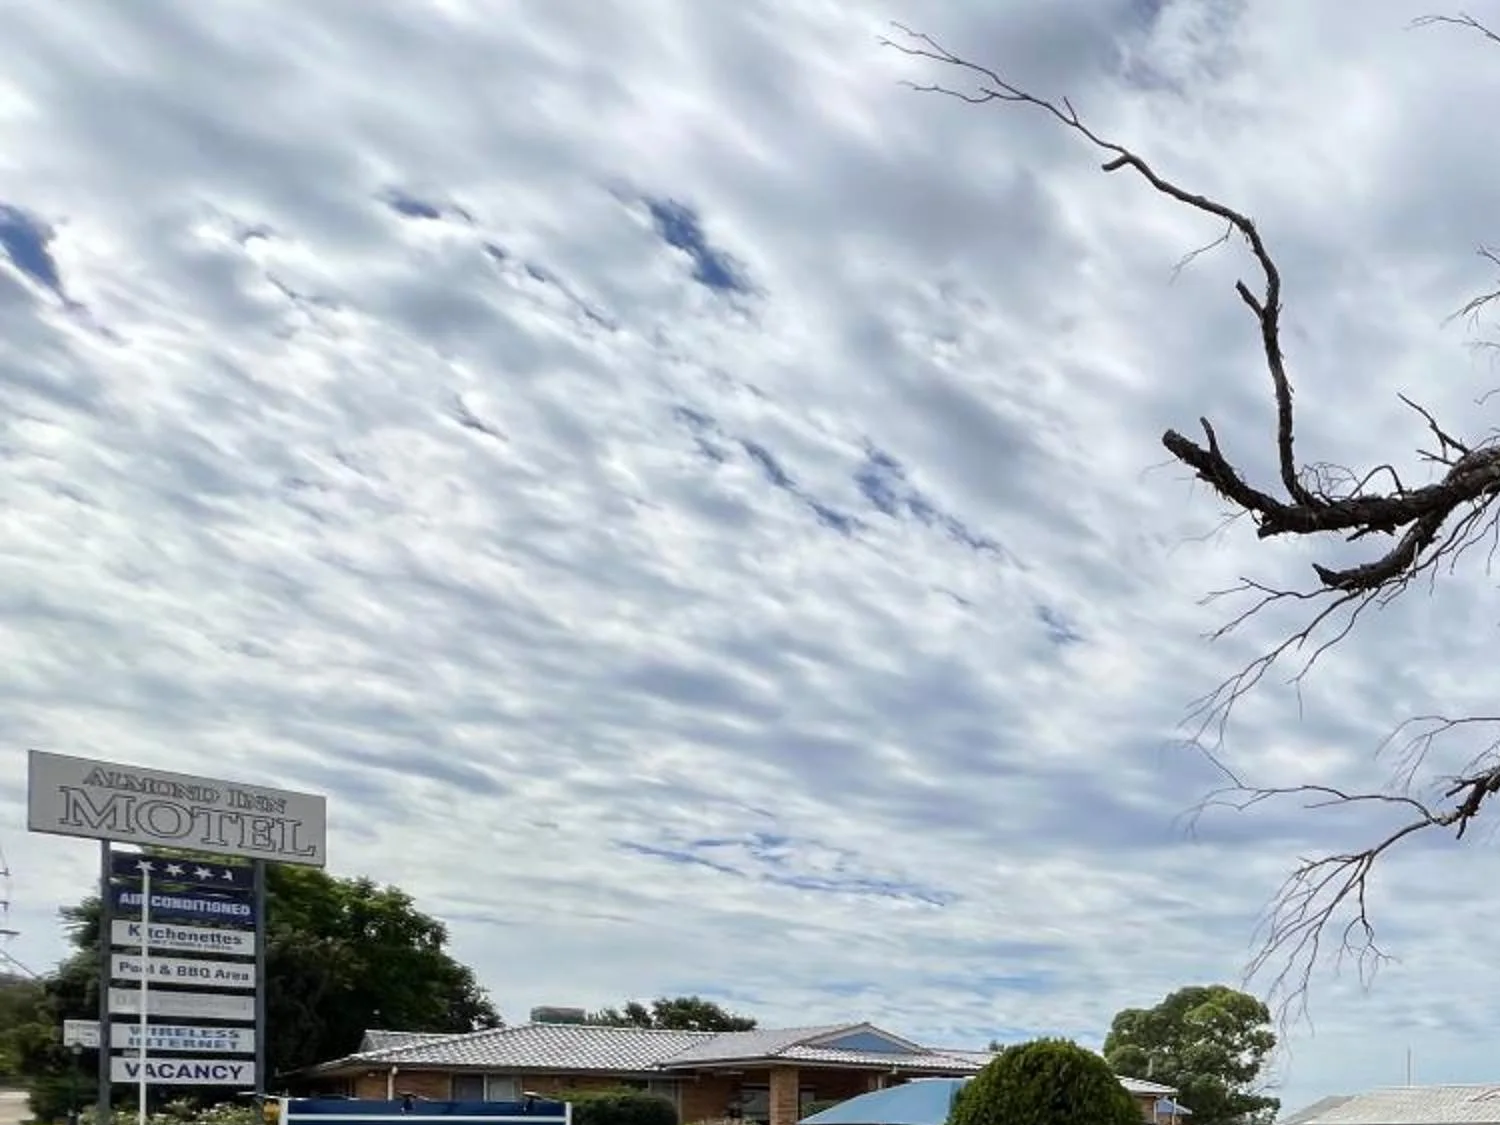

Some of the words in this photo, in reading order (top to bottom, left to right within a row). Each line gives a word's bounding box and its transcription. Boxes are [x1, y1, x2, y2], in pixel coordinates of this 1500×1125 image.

[83, 767, 220, 806] ALMOND
[228, 789, 288, 815] INN
[59, 786, 317, 857] MOTEL
[151, 895, 251, 915] CONDITIONED
[128, 923, 243, 945] Ktchenettes
[160, 964, 171, 975] &
[177, 965, 211, 978] BBQ
[214, 969, 249, 981] Area
[124, 1063, 243, 1080] VACANCY
